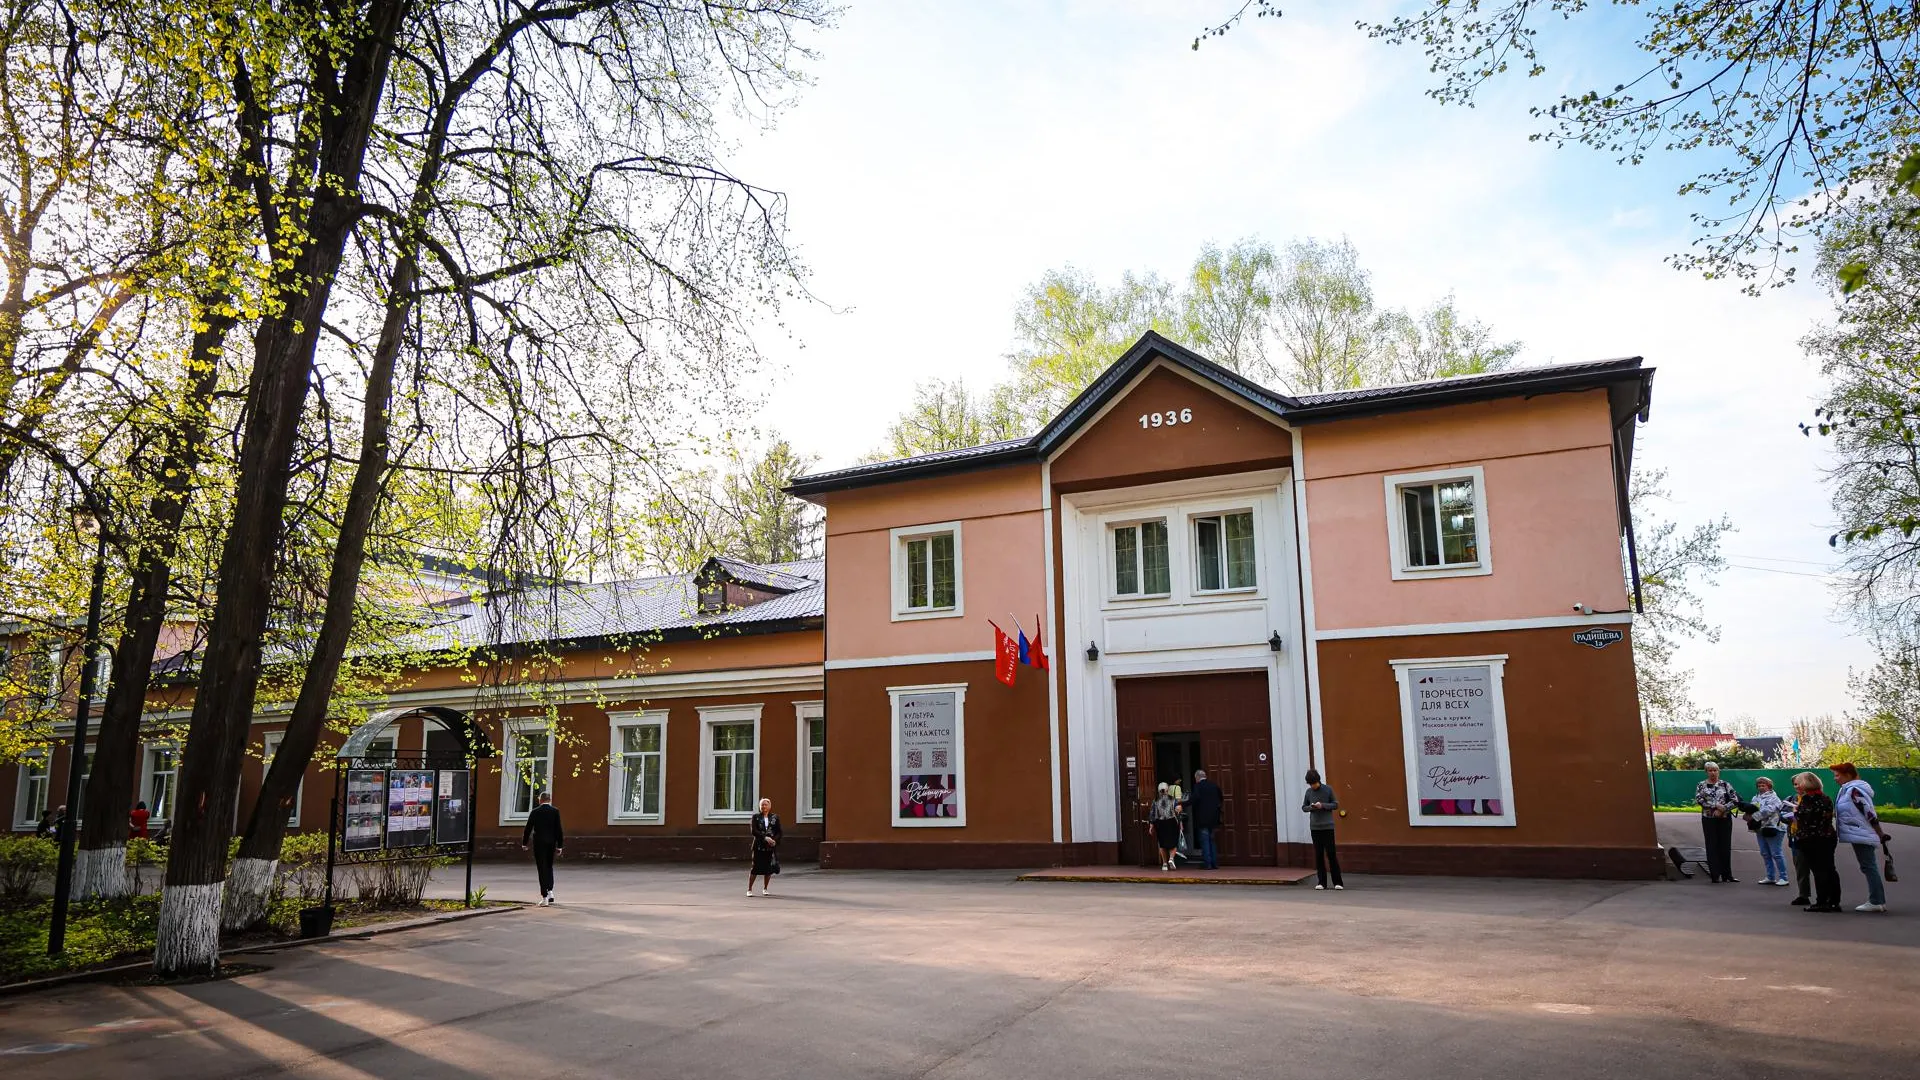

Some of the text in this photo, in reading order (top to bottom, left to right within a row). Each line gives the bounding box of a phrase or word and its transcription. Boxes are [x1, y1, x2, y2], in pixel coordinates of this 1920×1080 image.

[1139, 408, 1193, 429] 1936
[1576, 632, 1620, 641] РАДИЩЕВА
[1420, 688, 1483, 699] ТВОРЧЕСТВО
[1421, 700, 1470, 711] ДЛЯ ВСЕХ
[904, 712, 935, 720] КУЛЬТУРА
[904, 721, 929, 729] БЛИЖЕ,
[904, 729, 950, 738] ЧЕМ КАЖЕТСЯ
